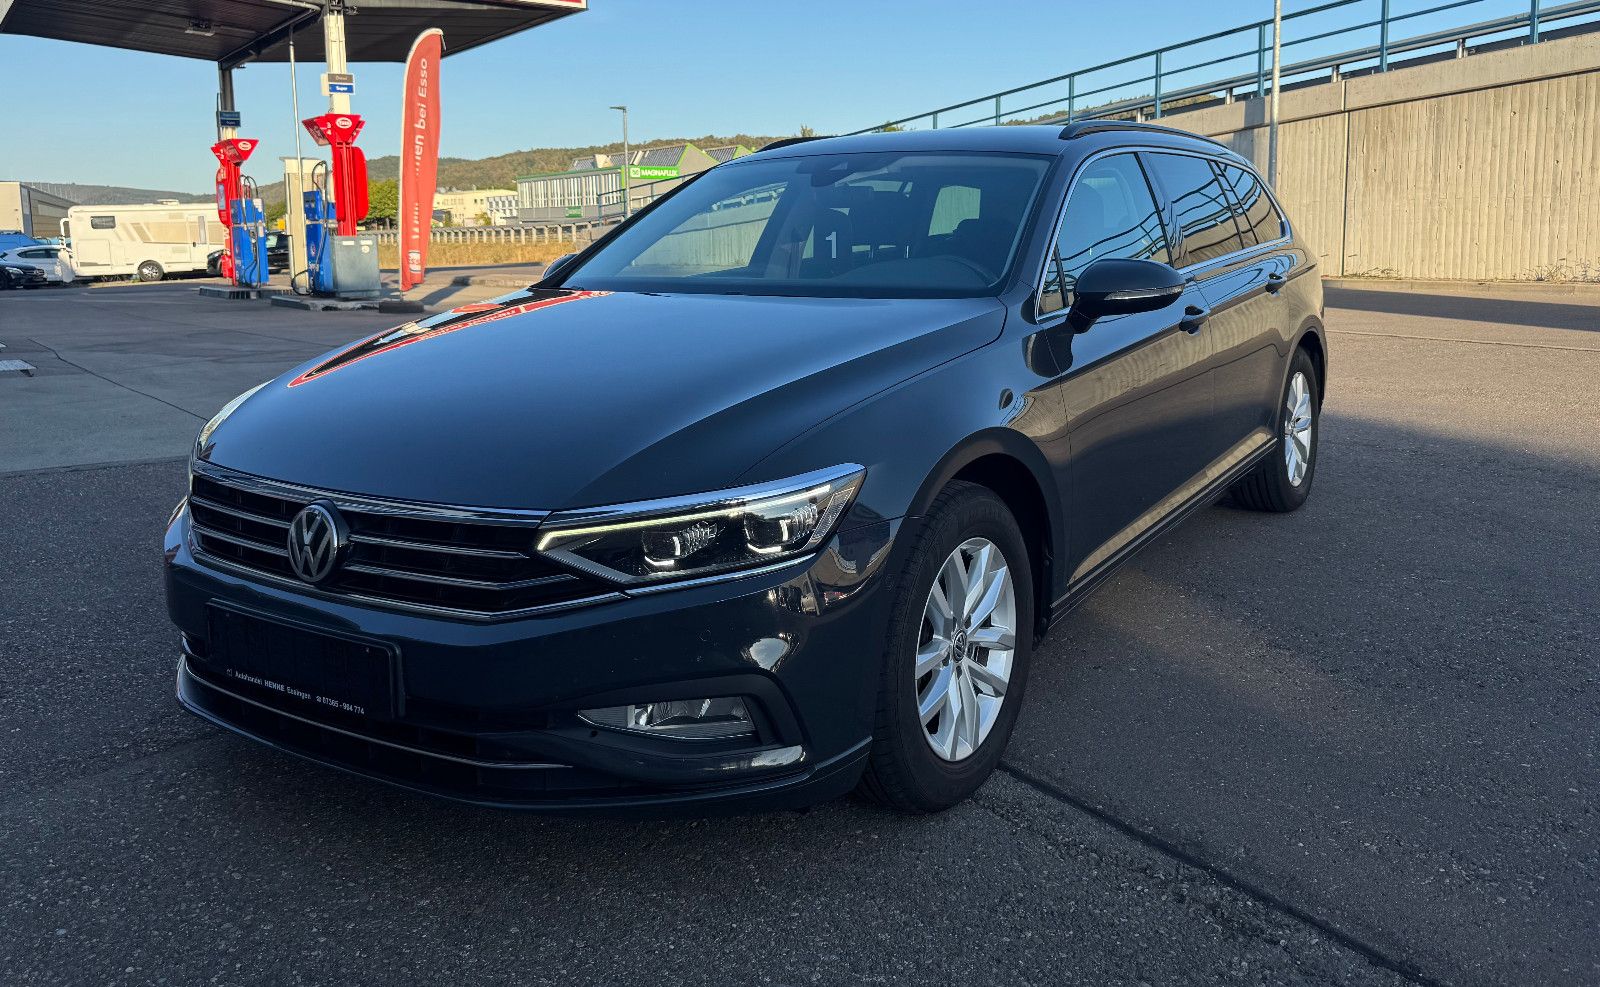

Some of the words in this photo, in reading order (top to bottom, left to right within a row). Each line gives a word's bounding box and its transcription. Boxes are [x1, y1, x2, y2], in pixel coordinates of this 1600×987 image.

[418, 58, 428, 97] Esso
[414, 103, 427, 130] bei
[641, 169, 678, 177] MAGNAFLUX
